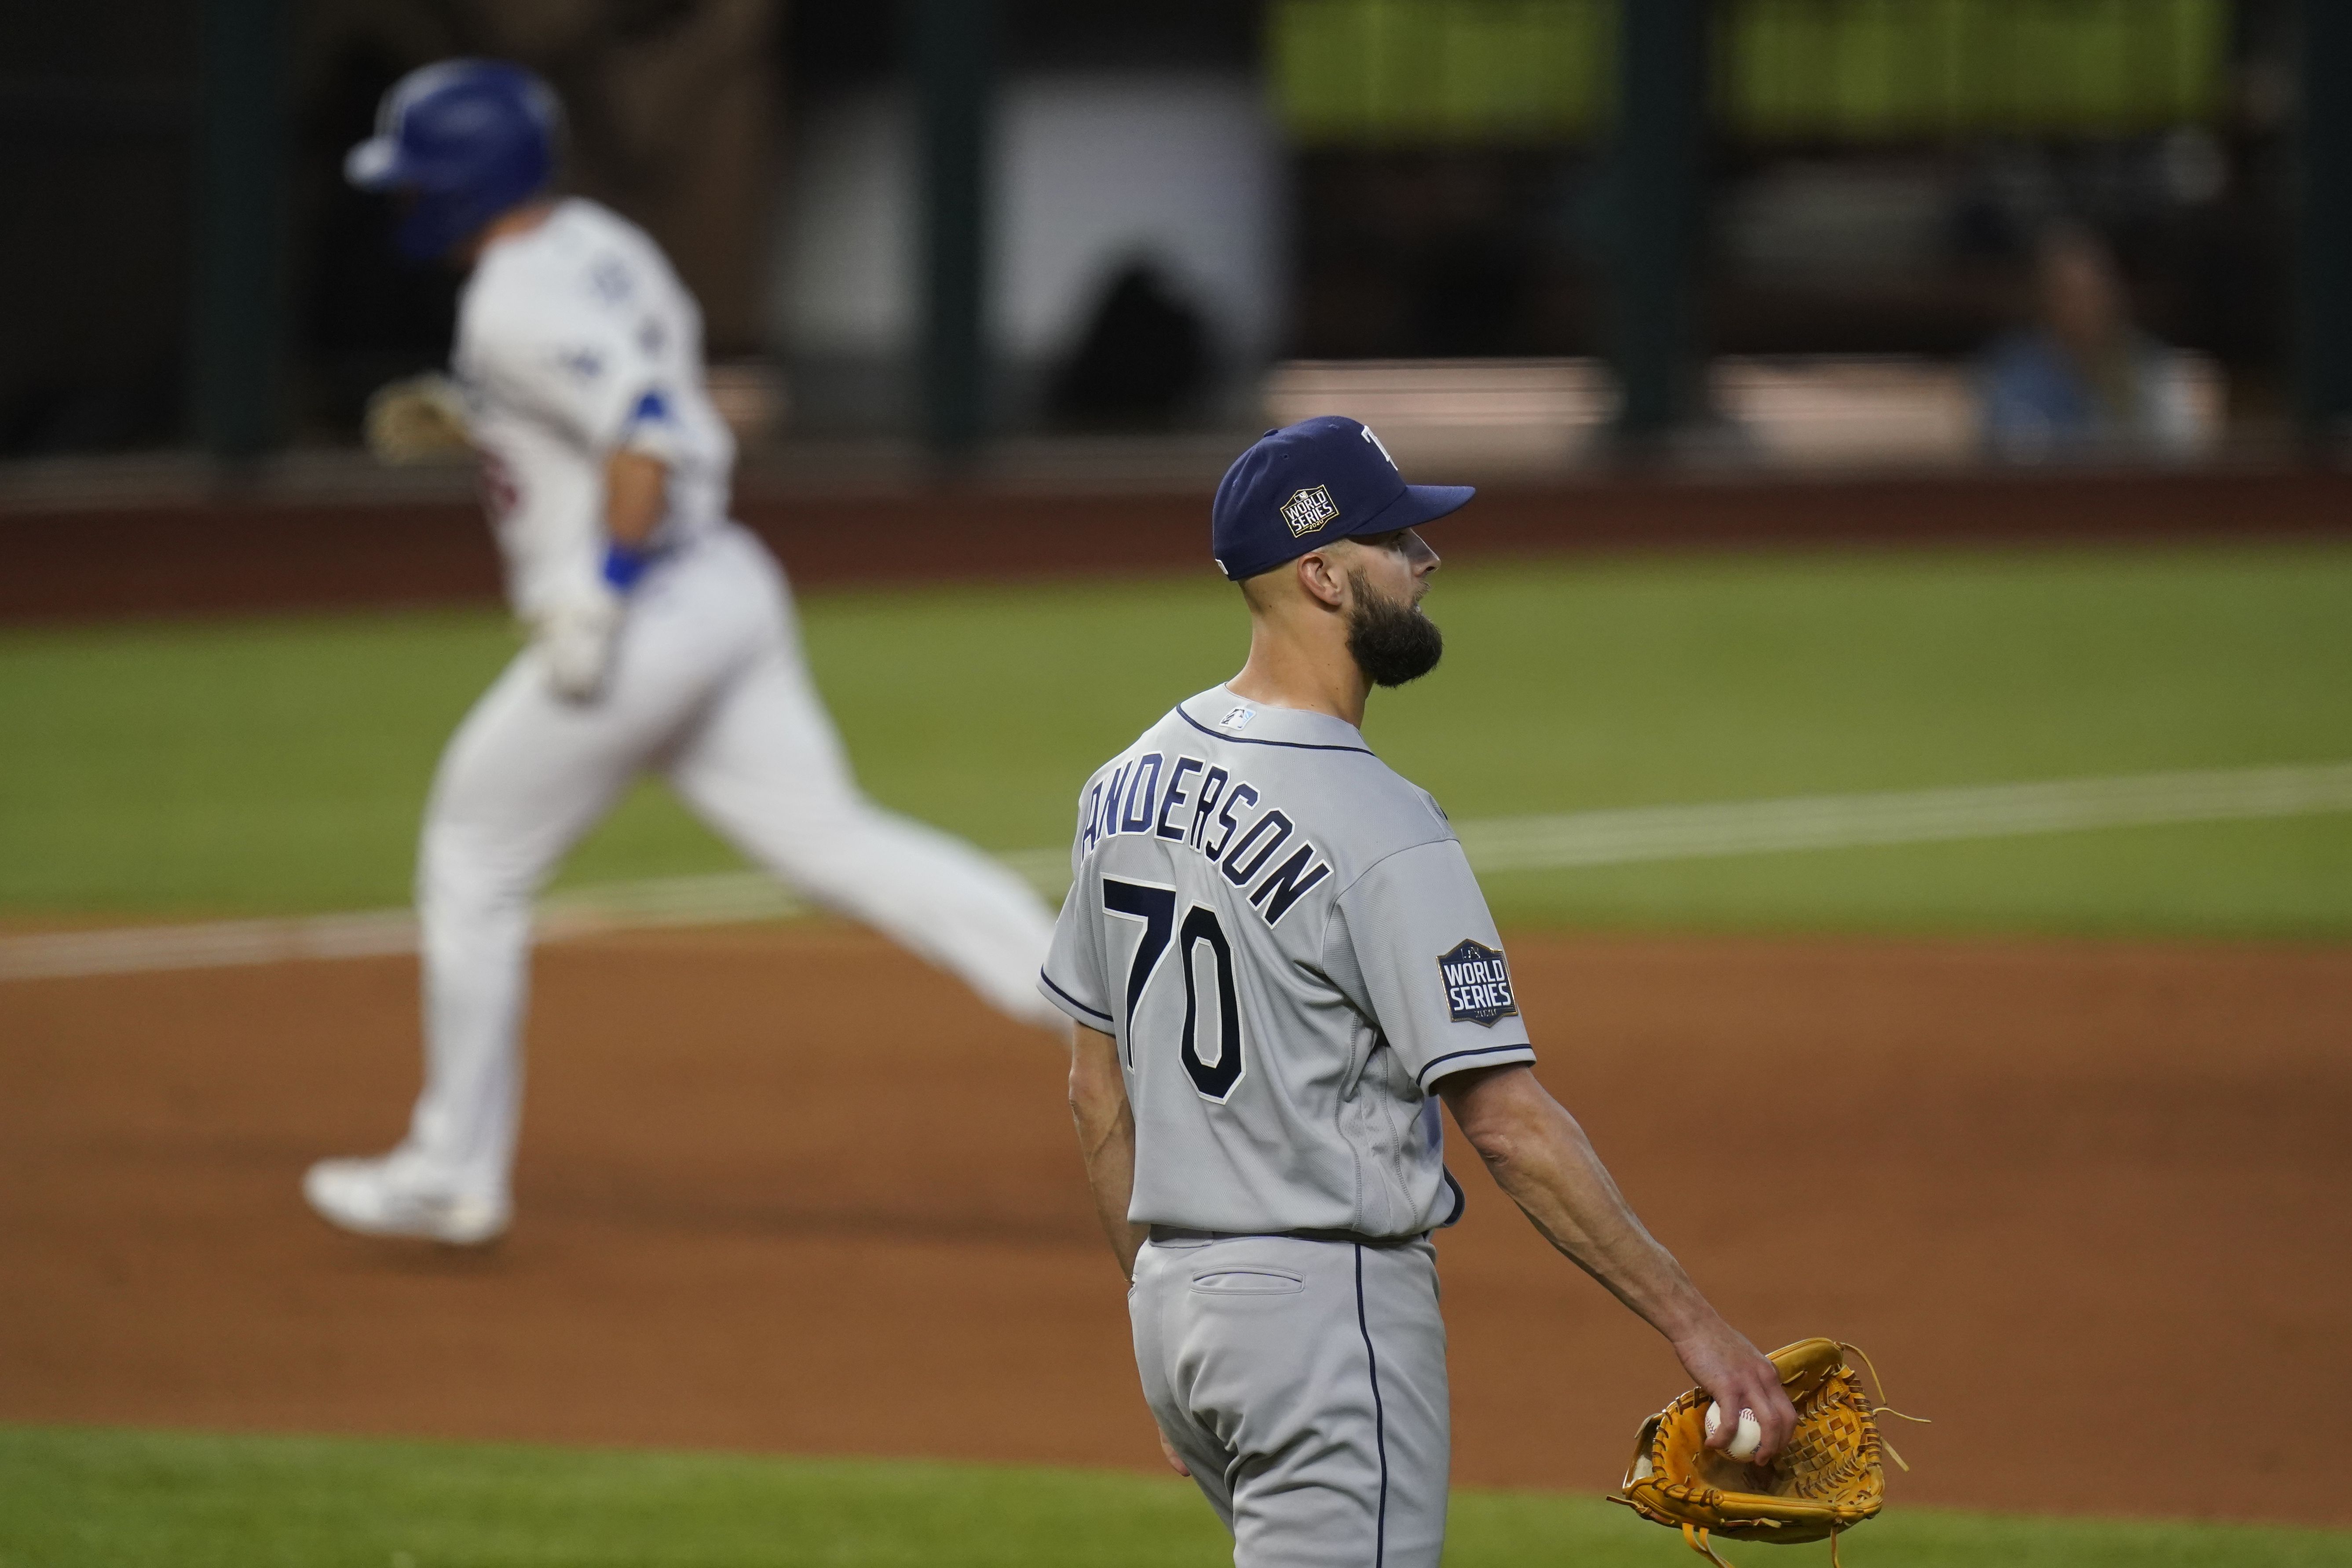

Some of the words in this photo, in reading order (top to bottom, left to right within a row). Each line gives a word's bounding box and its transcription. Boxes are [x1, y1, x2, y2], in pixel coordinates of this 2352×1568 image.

[1284, 491, 1327, 520] WORLD
[1291, 501, 1333, 531] SERIES
[1309, 519, 1324, 530] 2020
[1080, 750, 1334, 929] ANDERSON
[1444, 960, 1505, 986] WORLD
[1100, 872, 1247, 1105] 70
[1450, 982, 1511, 1011] SERIES
